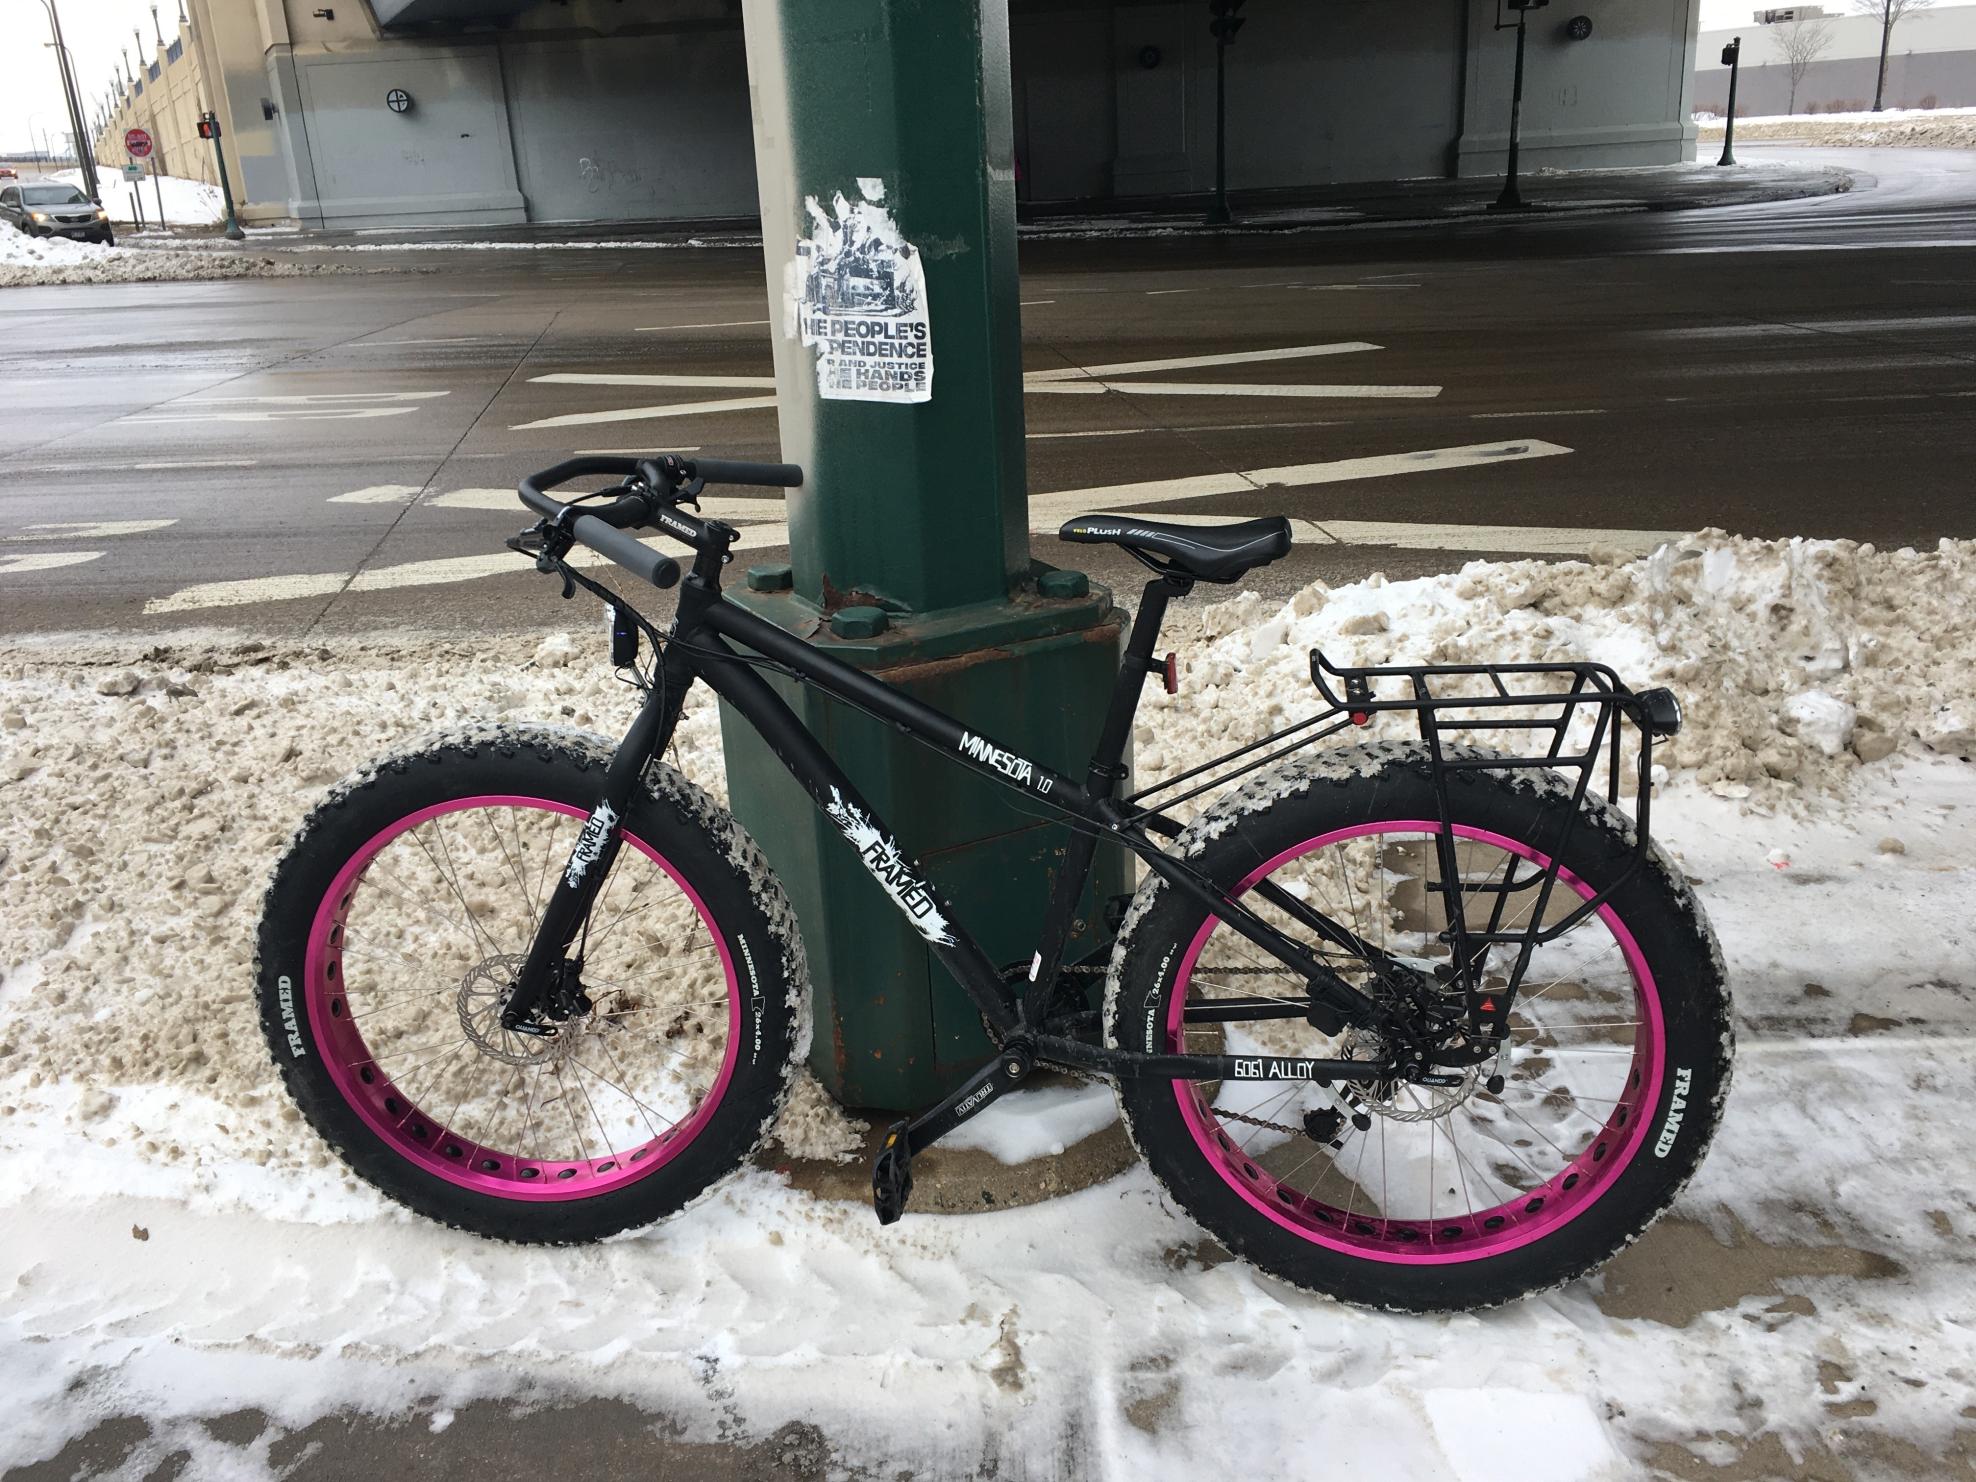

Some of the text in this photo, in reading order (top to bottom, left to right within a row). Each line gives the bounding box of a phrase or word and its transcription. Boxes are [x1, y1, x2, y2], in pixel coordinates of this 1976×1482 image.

[830, 319, 927, 340] PEOPLE'S
[838, 359, 867, 368] AND
[869, 361, 926, 370] JUSTICE
[855, 368, 927, 382] HANDS
[855, 379, 927, 393] PEOPLE
[660, 514, 697, 538] FRAMED
[958, 731, 1054, 794] MINNESOTA 1.0
[575, 816, 605, 863] FRAMED
[861, 840, 934, 919] FRAMED
[737, 933, 760, 997] MINNESOTA
[278, 975, 306, 1058] FRAMED
[1234, 1058, 1315, 1079] 6061 ALLOY
[1654, 1067, 1692, 1158] FRAMED
